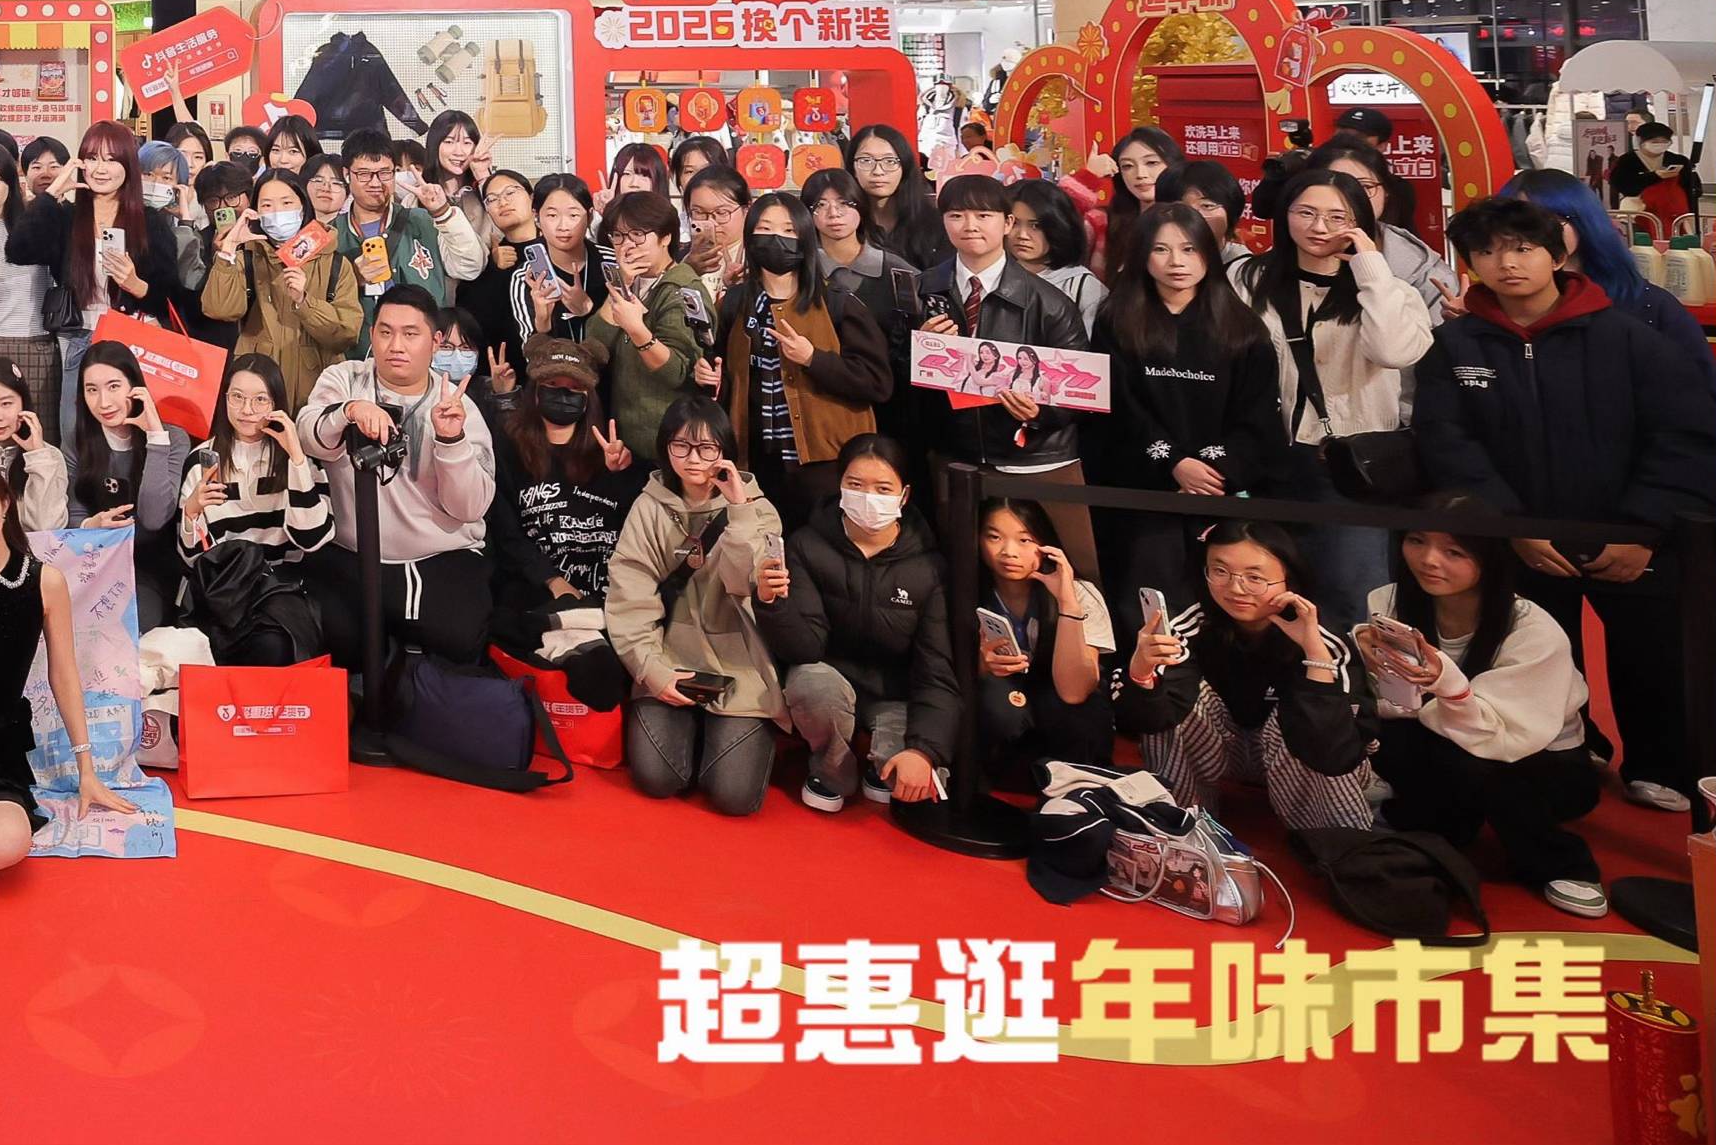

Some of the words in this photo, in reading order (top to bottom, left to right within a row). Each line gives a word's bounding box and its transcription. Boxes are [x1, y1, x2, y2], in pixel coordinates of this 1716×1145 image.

[628, 7, 893, 43] 2026换个新装
[1185, 125, 1241, 141] 欢洗马上来
